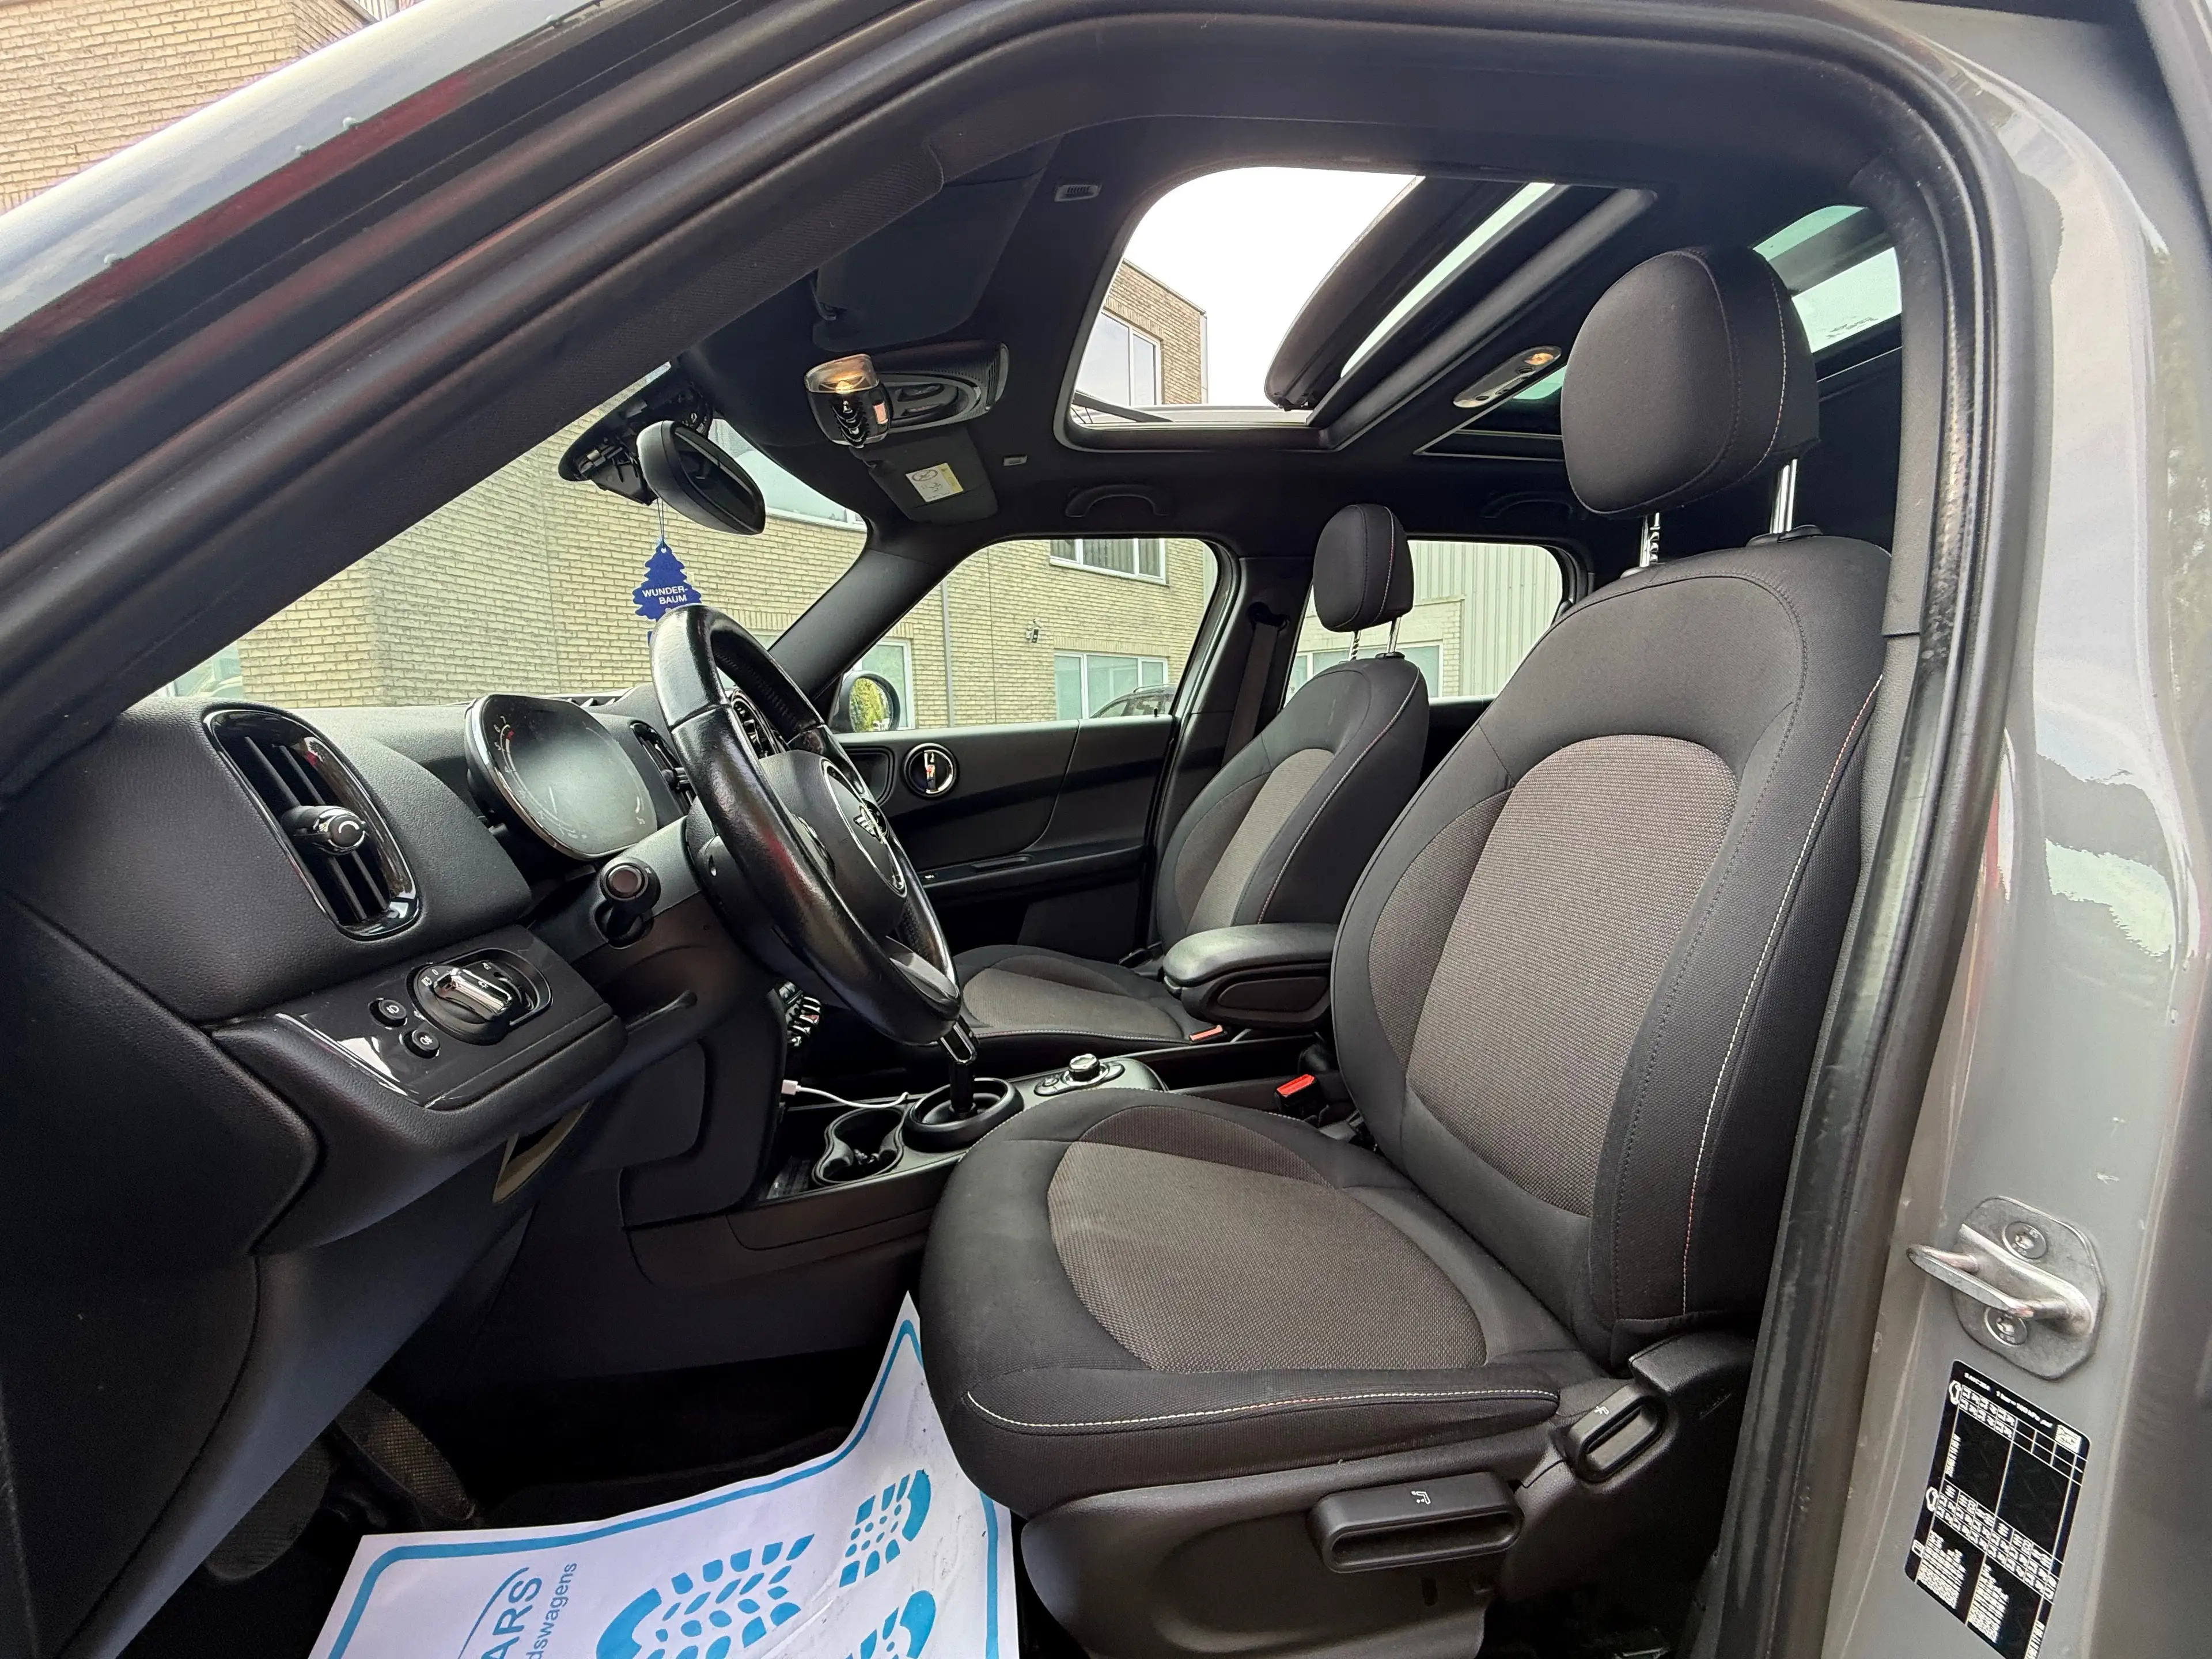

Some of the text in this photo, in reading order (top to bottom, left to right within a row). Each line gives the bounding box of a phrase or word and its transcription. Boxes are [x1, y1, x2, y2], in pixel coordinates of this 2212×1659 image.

[642, 585, 688, 597] WUNDER-
[658, 594, 687, 604] BAUM
[494, 741, 501, 751] 5
